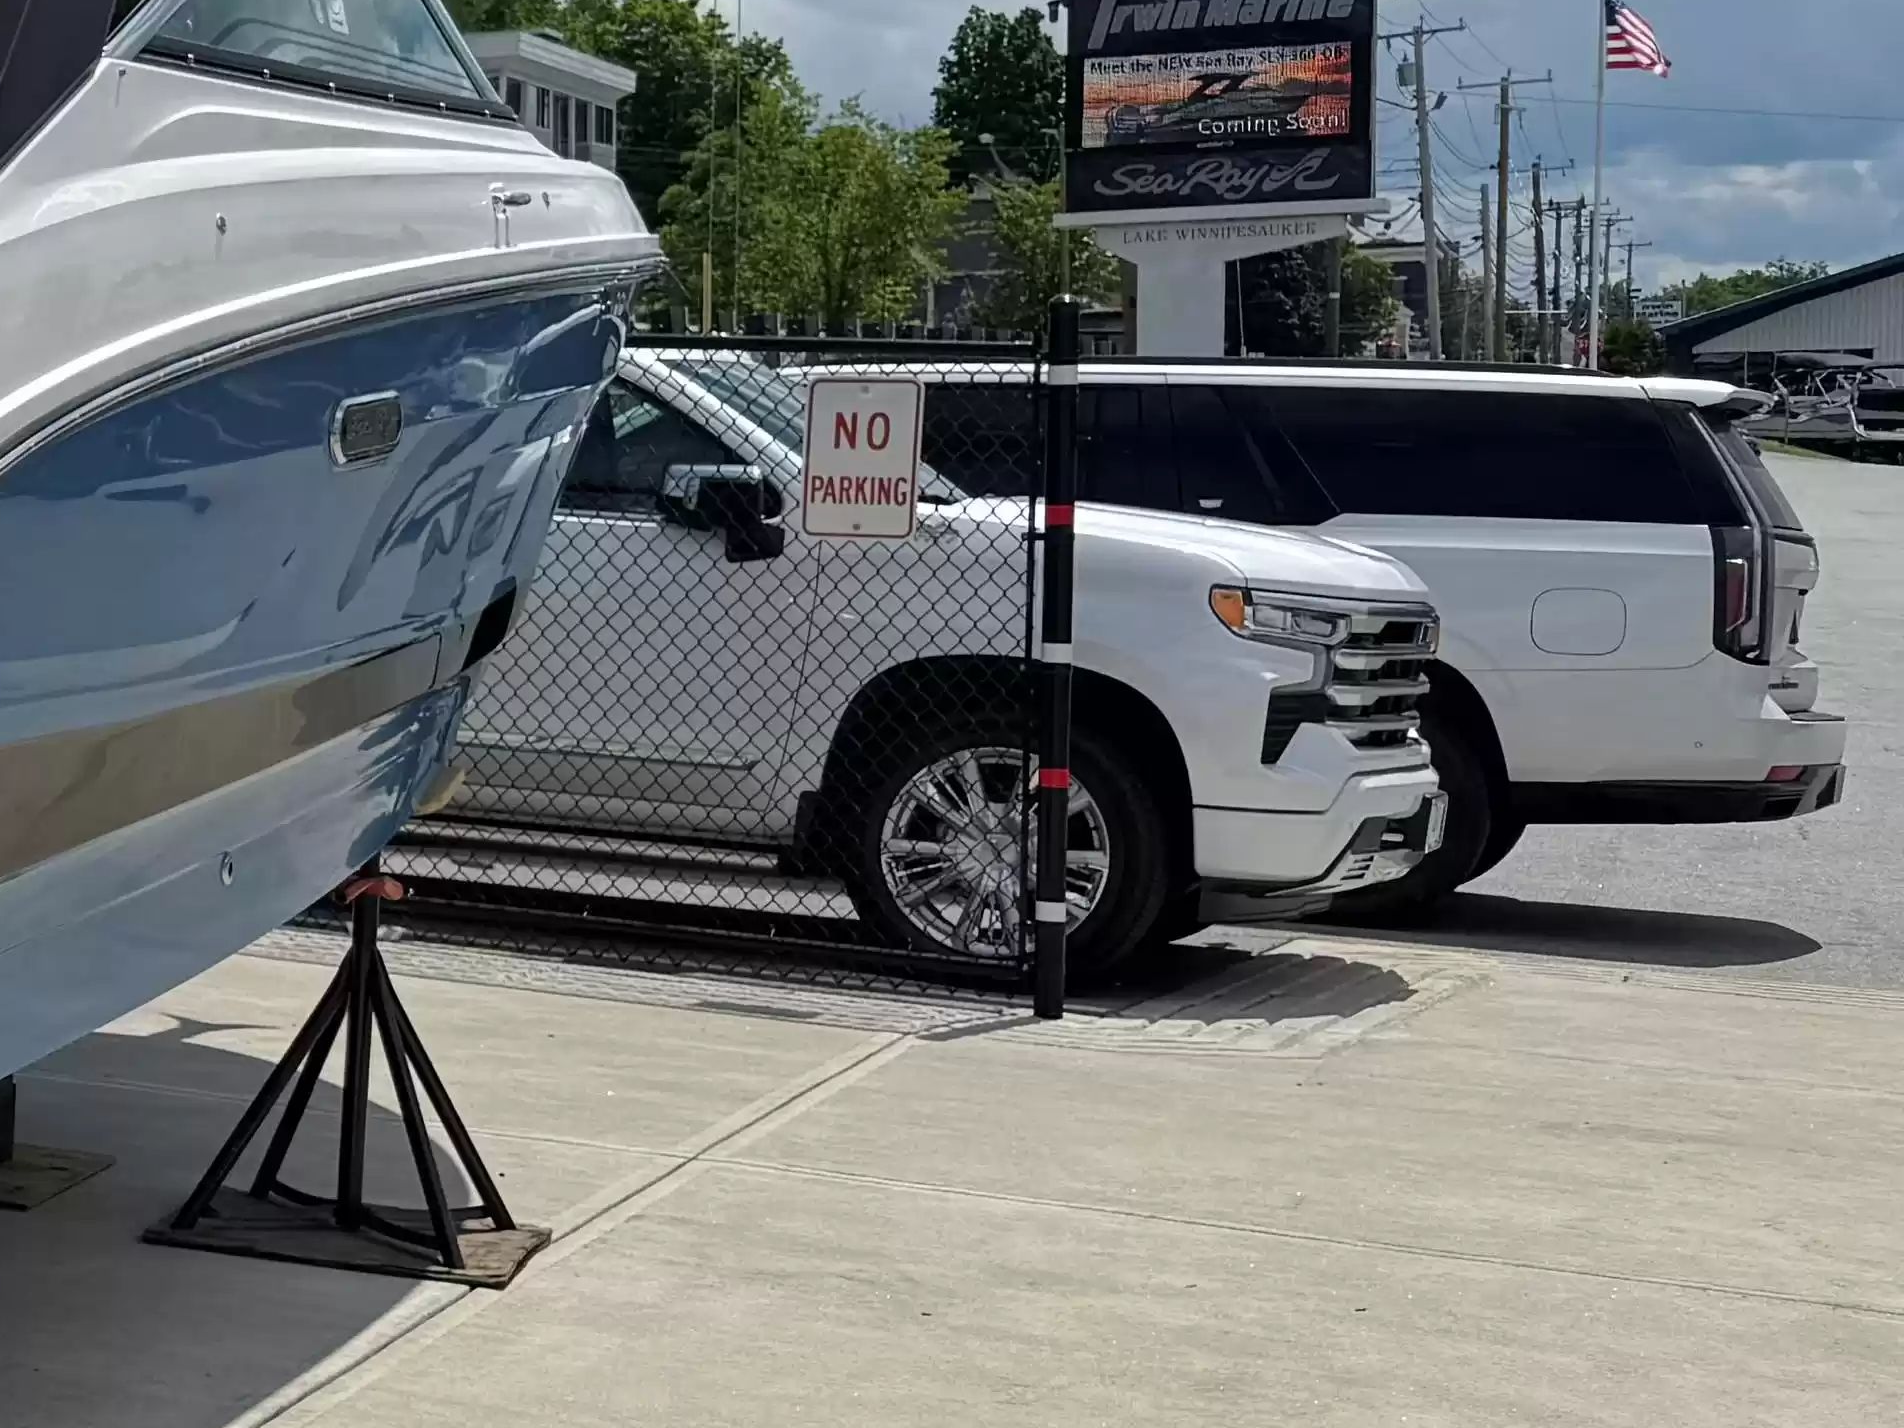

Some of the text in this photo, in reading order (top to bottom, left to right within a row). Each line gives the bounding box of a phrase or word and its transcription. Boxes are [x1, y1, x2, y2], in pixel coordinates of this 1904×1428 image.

[1198, 108, 1347, 137] Coming Soon!
[1094, 157, 1269, 201] Sea Ray
[1123, 227, 1169, 245] LAKE
[833, 411, 891, 451] NO
[810, 475, 908, 506] PARKING
